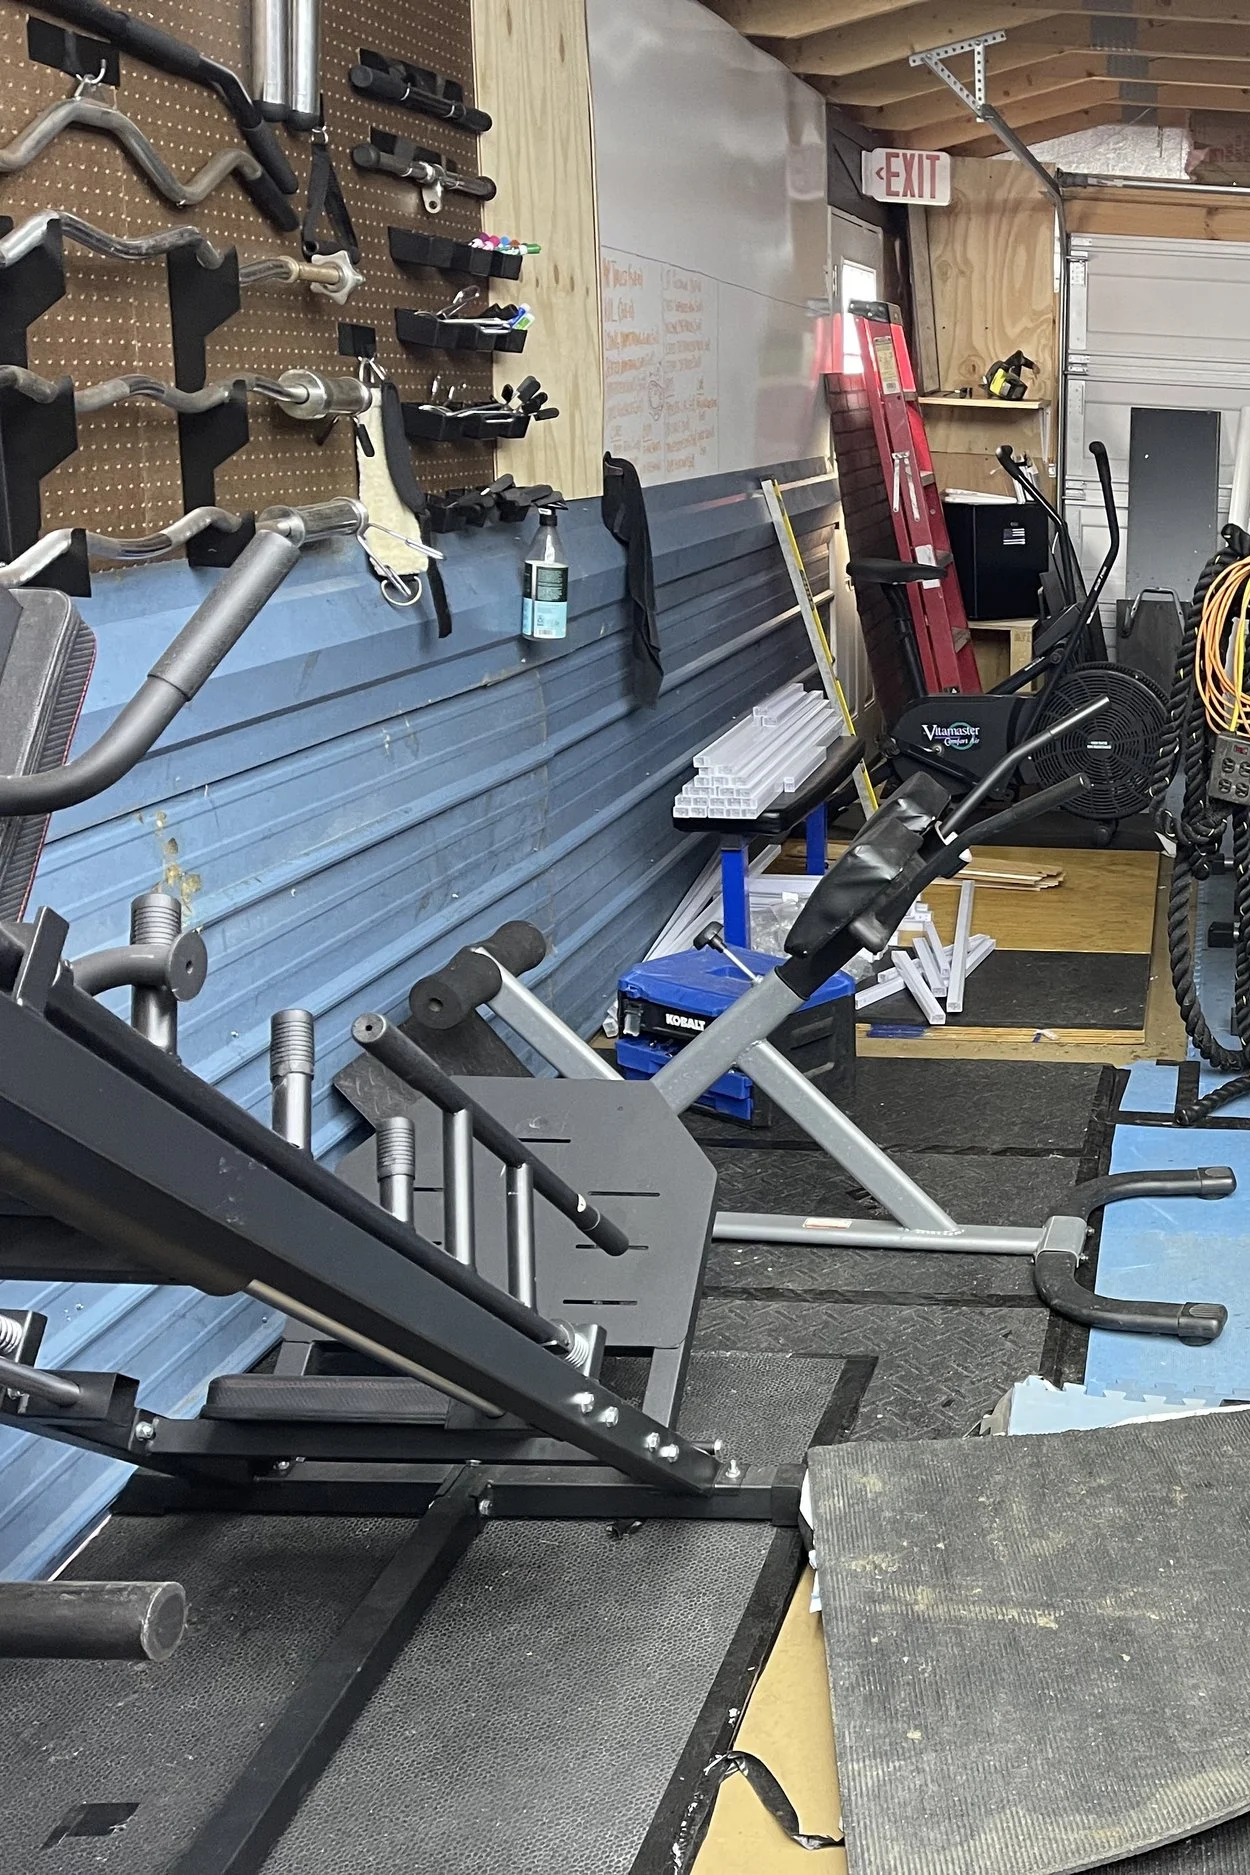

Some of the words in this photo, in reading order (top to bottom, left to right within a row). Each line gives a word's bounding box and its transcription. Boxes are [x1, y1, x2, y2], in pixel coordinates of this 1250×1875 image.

[885, 151, 940, 199] EXIT
[921, 724, 980, 742] Vitamaster
[665, 1013, 706, 1031] KOBALT
